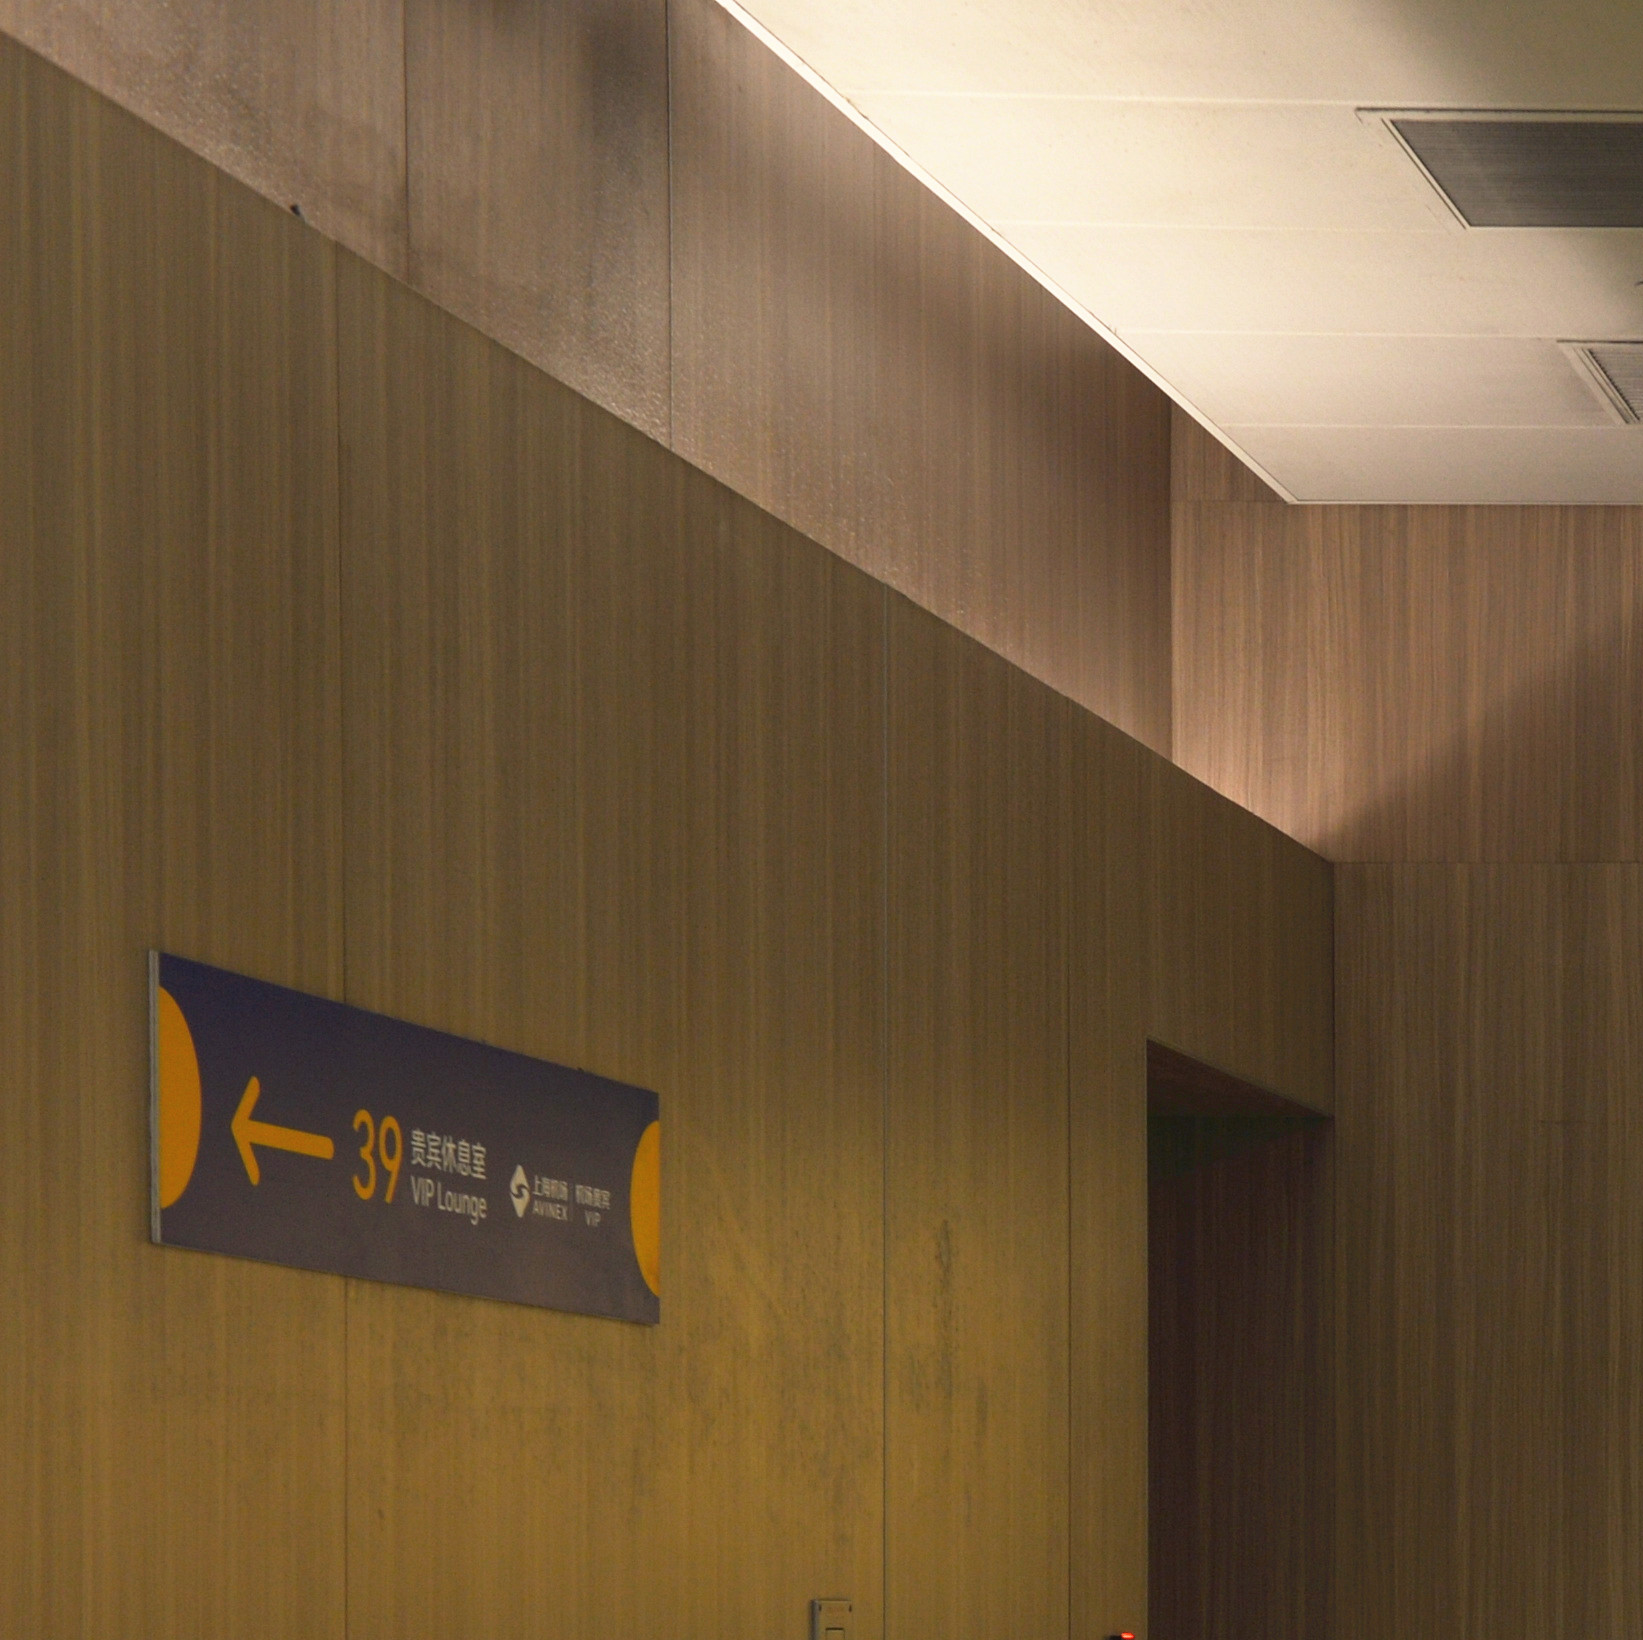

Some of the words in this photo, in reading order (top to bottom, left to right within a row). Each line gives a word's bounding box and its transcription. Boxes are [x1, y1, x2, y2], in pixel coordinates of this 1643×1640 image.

[352, 1108, 403, 1205] 39
[410, 1127, 488, 1181] 贵宾休息室
[410, 1174, 435, 1208] VIP
[437, 1181, 488, 1226] Lounge
